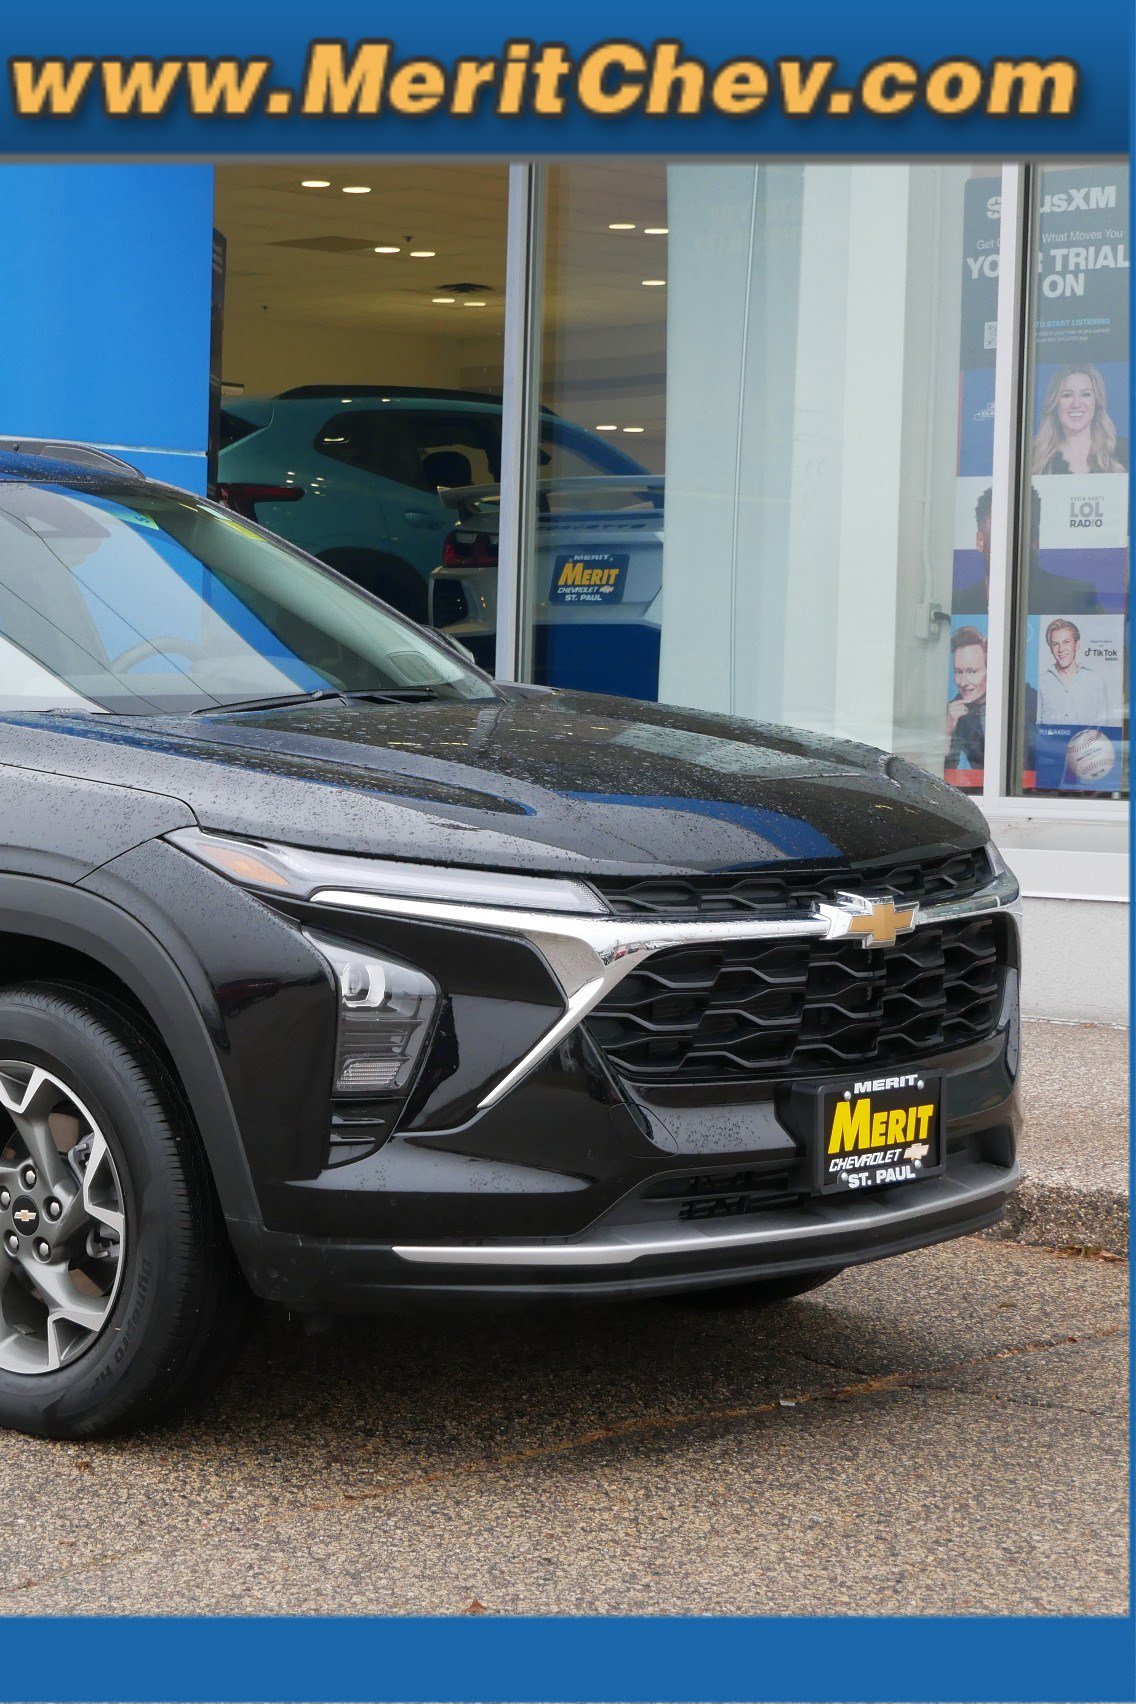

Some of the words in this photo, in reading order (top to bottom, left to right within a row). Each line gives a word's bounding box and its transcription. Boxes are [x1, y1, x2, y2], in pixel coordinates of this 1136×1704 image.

[986, 185, 1116, 219] SusXM
[1042, 233, 1067, 243] What
[1070, 230, 1102, 241] Moves
[1105, 228, 1123, 239] You
[1050, 245, 1130, 271] TRIAL
[1043, 273, 1085, 298] ON
[1070, 502, 1104, 518] LOL
[1070, 519, 1103, 528] RADIO
[558, 562, 620, 586] MERIT
[557, 586, 599, 594] CHEVROLET
[1093, 649, 1118, 657] TikTok
[854, 1074, 919, 1094] MERIT
[827, 1098, 934, 1155] MERIT
[829, 1148, 903, 1172] CHEVROLET
[848, 1173, 872, 1189] ST.
[875, 1165, 916, 1186] PAUL
